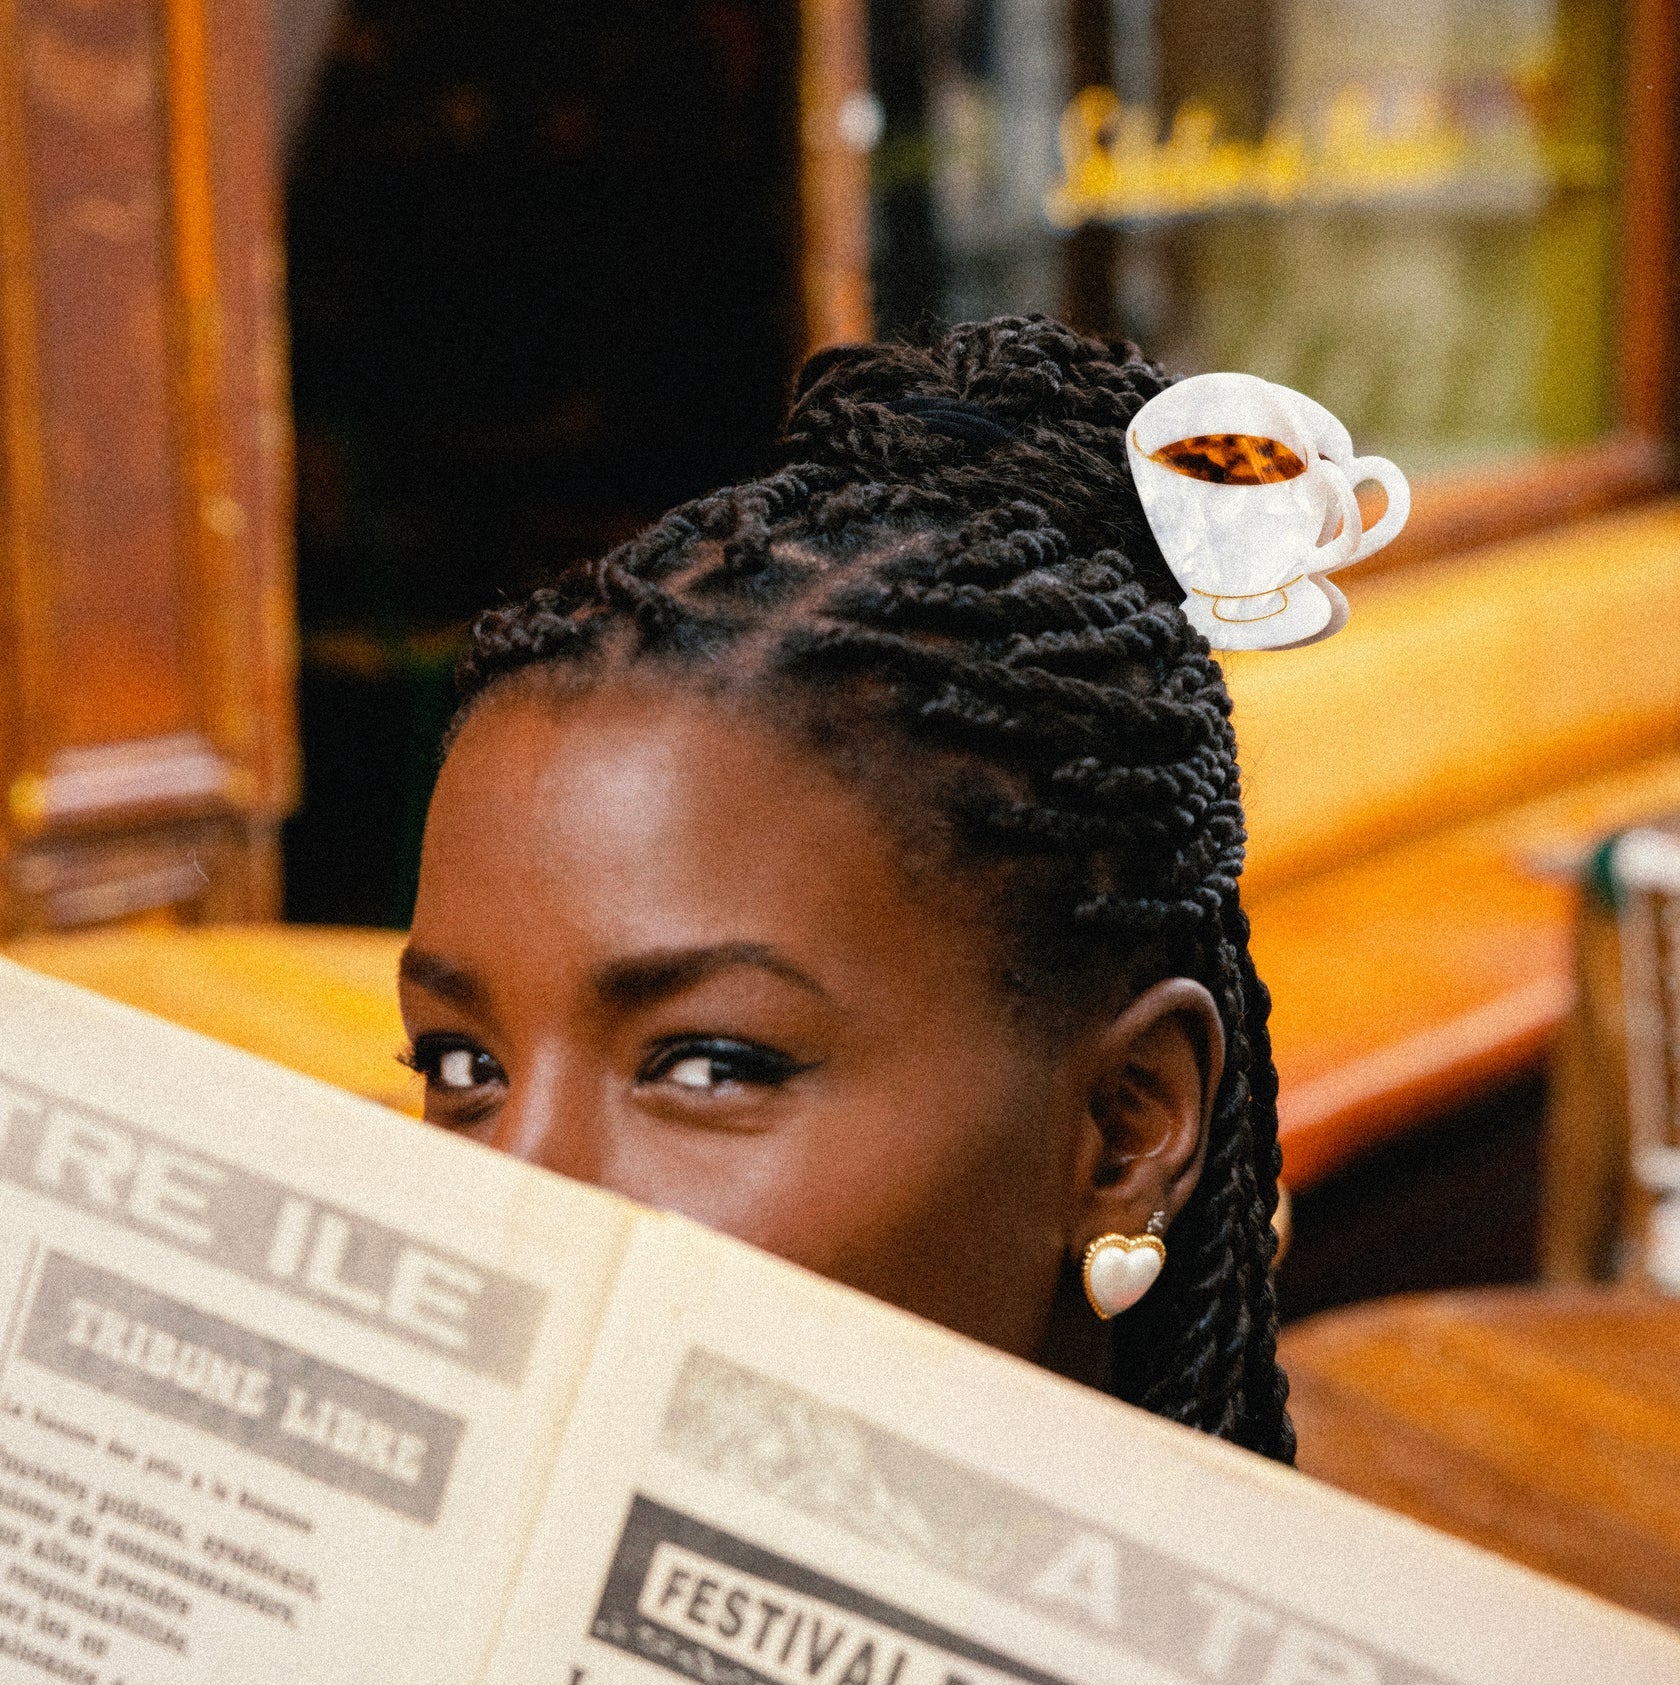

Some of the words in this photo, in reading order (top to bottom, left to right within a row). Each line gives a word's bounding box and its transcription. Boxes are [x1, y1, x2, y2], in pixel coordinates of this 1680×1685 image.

[267, 1200, 484, 1346] ILE
[66, 1299, 273, 1419] TRIBUNE
[280, 1387, 429, 1486] LIBRE
